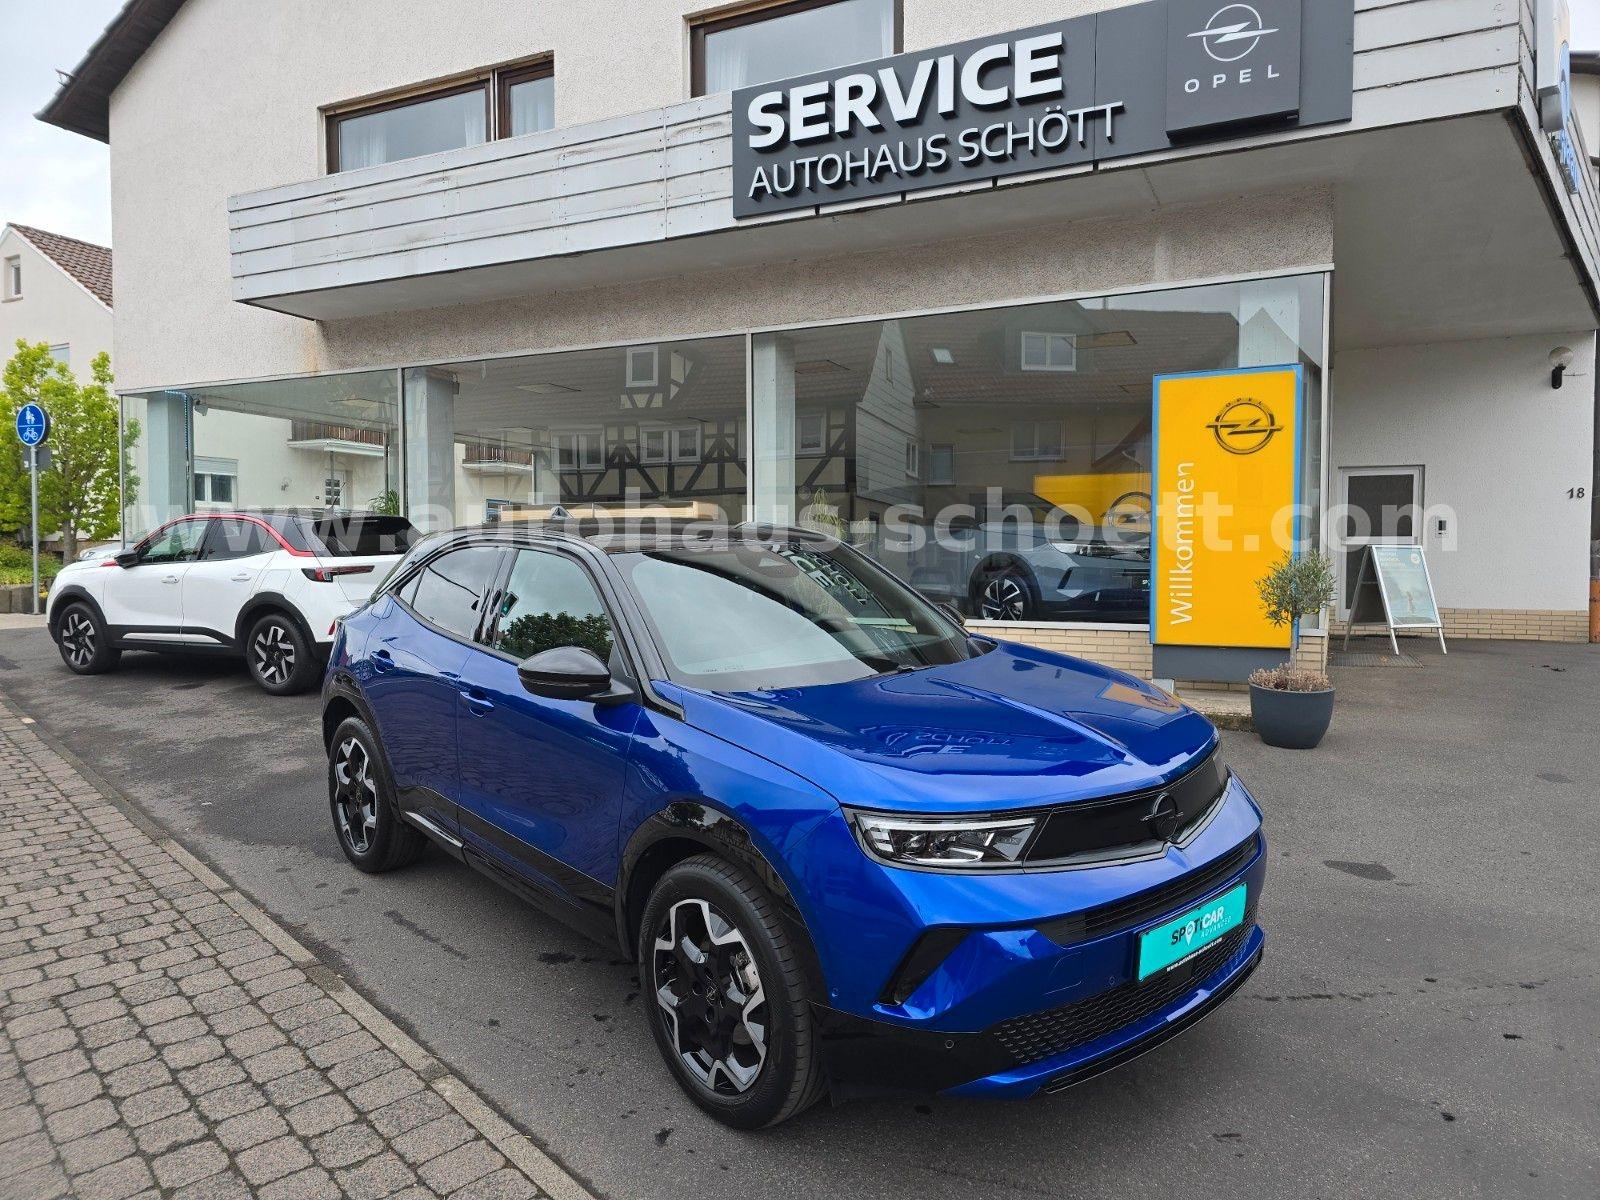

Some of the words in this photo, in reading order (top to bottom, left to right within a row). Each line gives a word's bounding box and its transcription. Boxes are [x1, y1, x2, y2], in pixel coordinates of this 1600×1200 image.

[747, 31, 1064, 150] SERVICE
[1184, 64, 1280, 93] OPEL
[748, 133, 949, 198] AUTOHAUS
[958, 100, 1123, 163] SCHÖTT
[1566, 487, 1585, 499] 18
[1168, 462, 1195, 625] Willkommen
